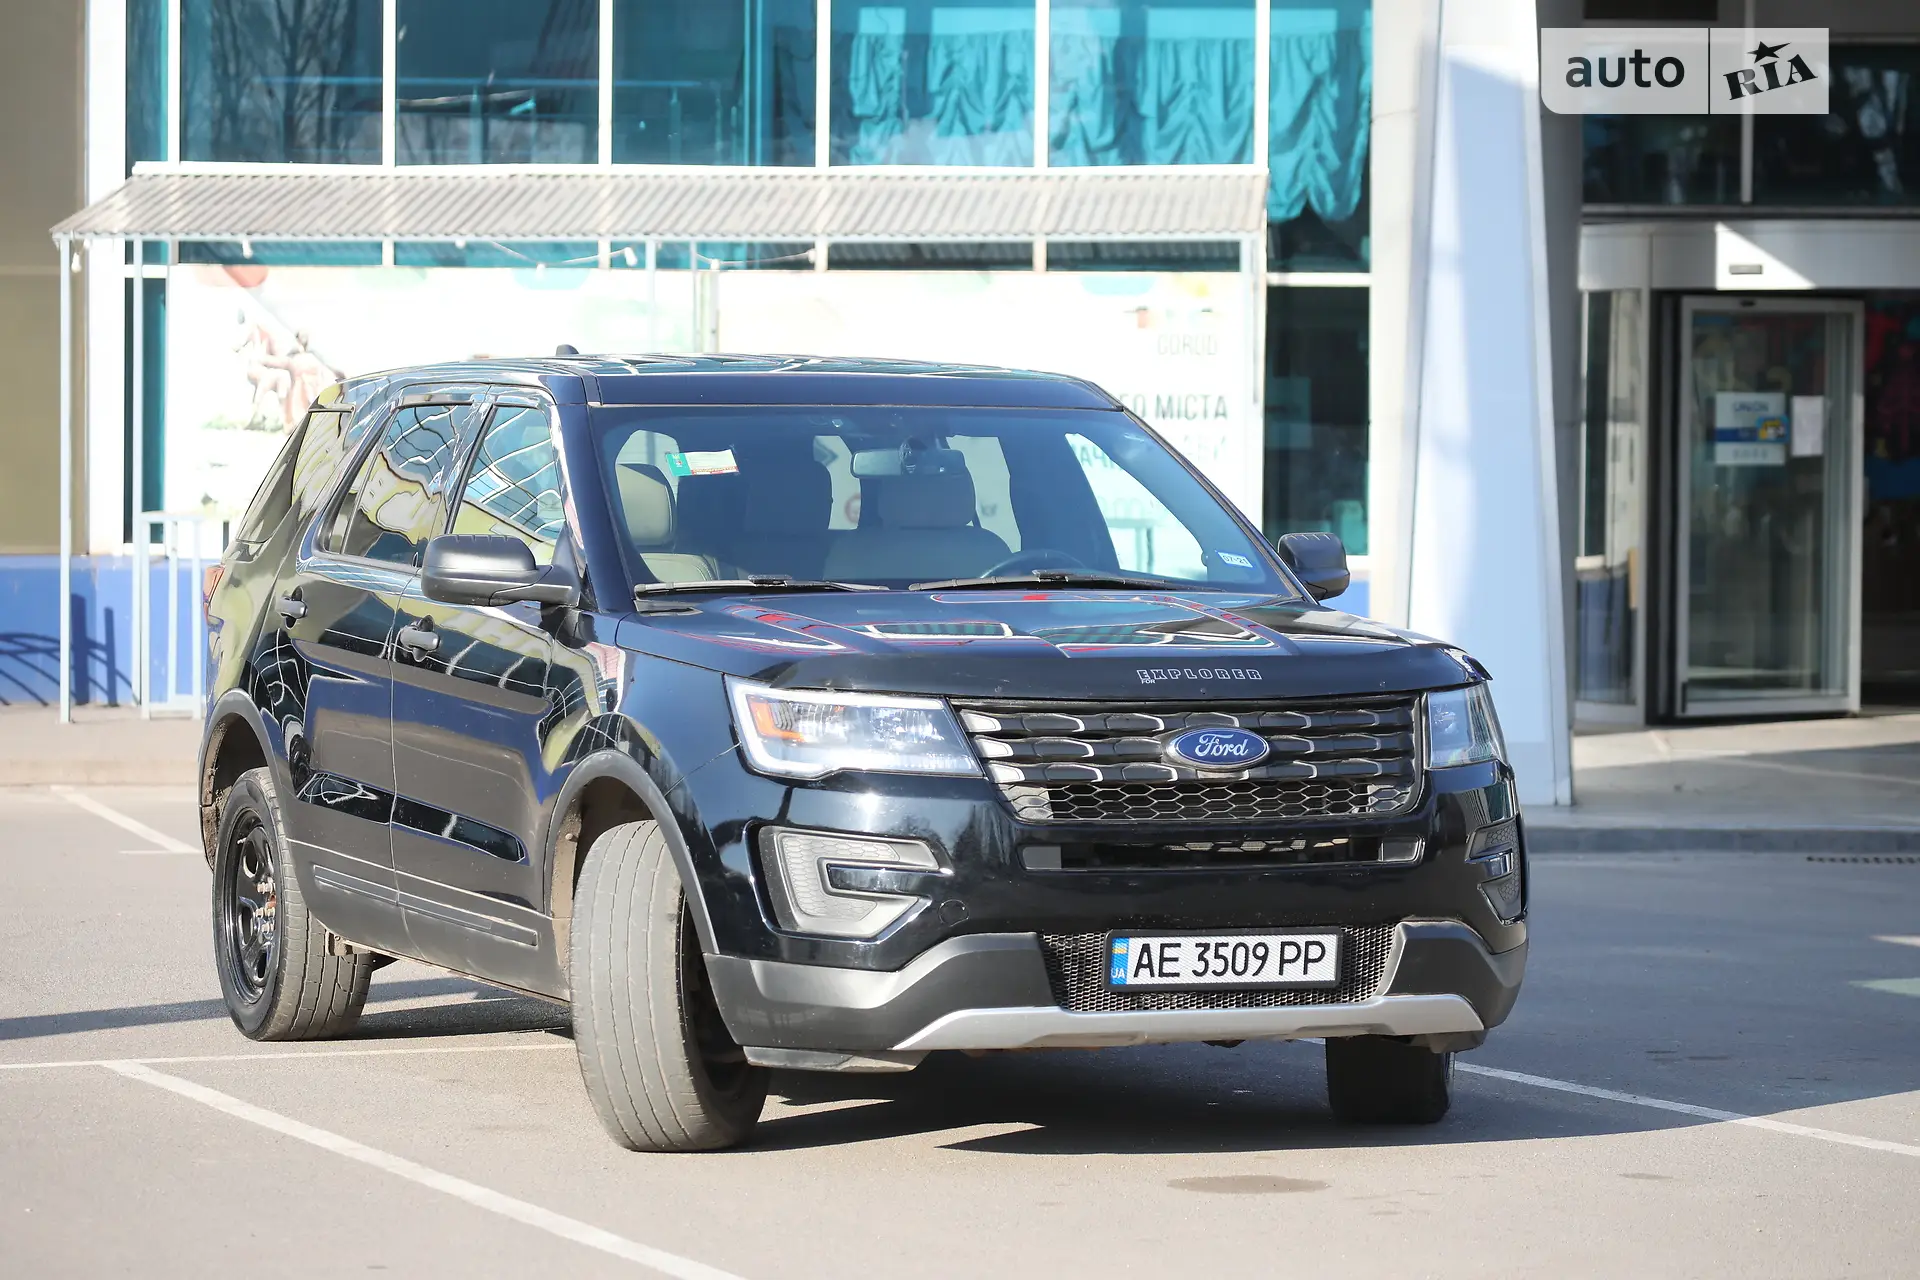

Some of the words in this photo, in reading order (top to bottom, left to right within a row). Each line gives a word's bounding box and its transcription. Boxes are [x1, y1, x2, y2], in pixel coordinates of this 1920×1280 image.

[1155, 393, 1228, 421] МІСТА
[1136, 668, 1262, 680] EXPLORER
[1195, 733, 1250, 757] Ford
[1134, 943, 1181, 978] AE
[1192, 942, 1269, 977] 3509
[1278, 940, 1326, 976] PP
